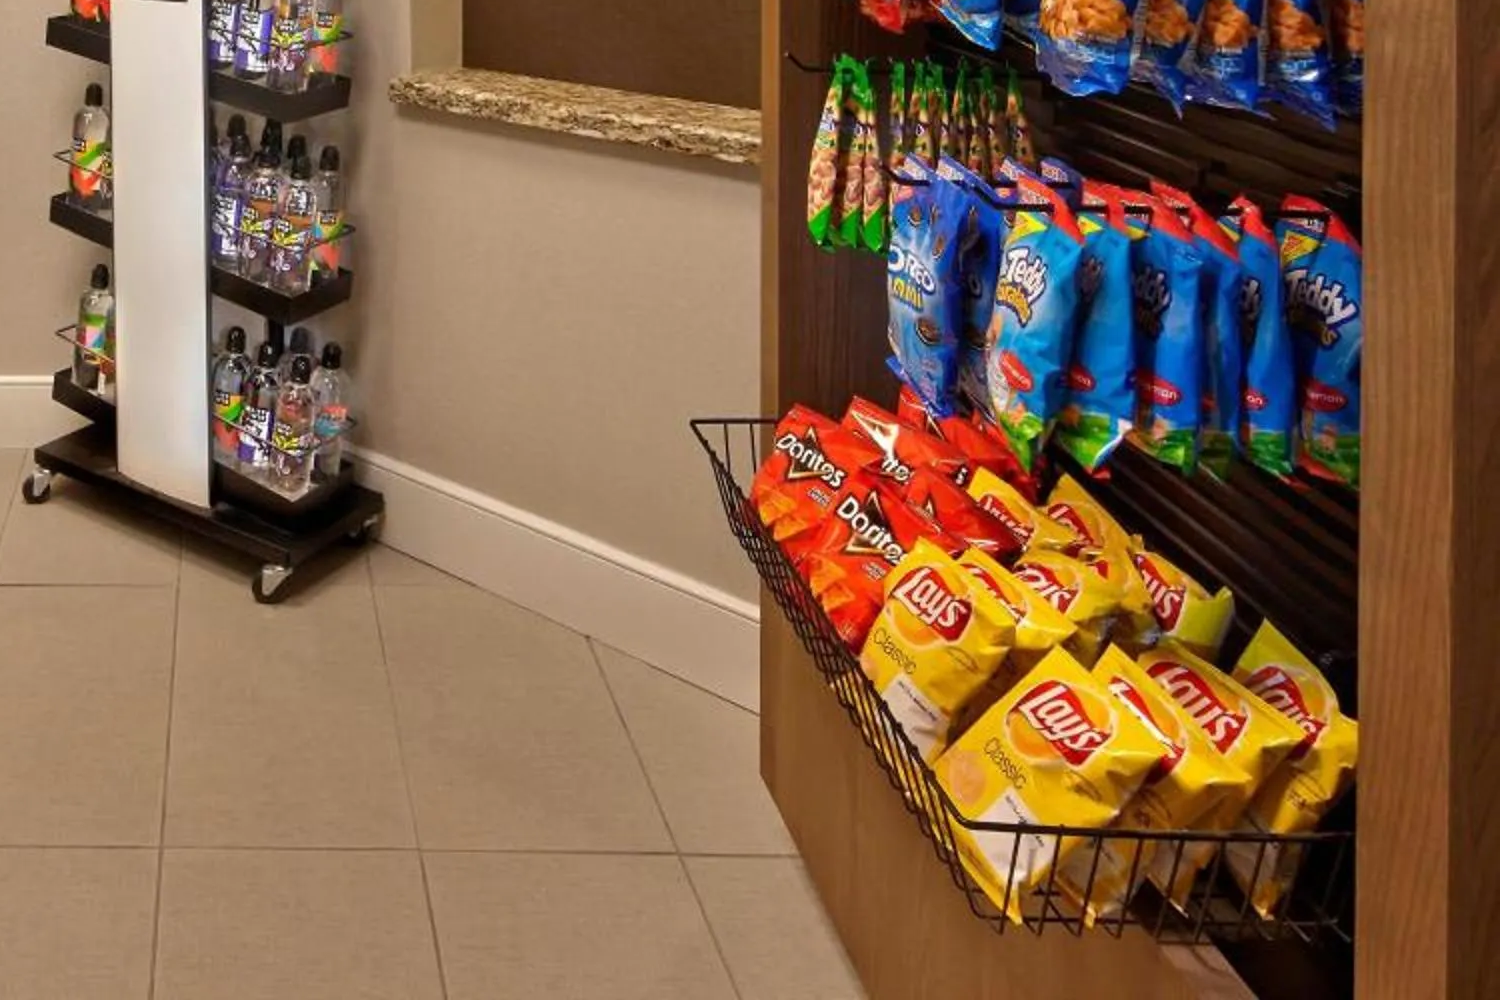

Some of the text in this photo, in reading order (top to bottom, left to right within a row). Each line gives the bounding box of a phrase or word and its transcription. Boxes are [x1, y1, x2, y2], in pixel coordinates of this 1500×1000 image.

[1284, 269, 1356, 325] Teddy
[775, 432, 847, 488] Doritos
[836, 495, 907, 566] Doritos
[983, 735, 1029, 791] Classic
